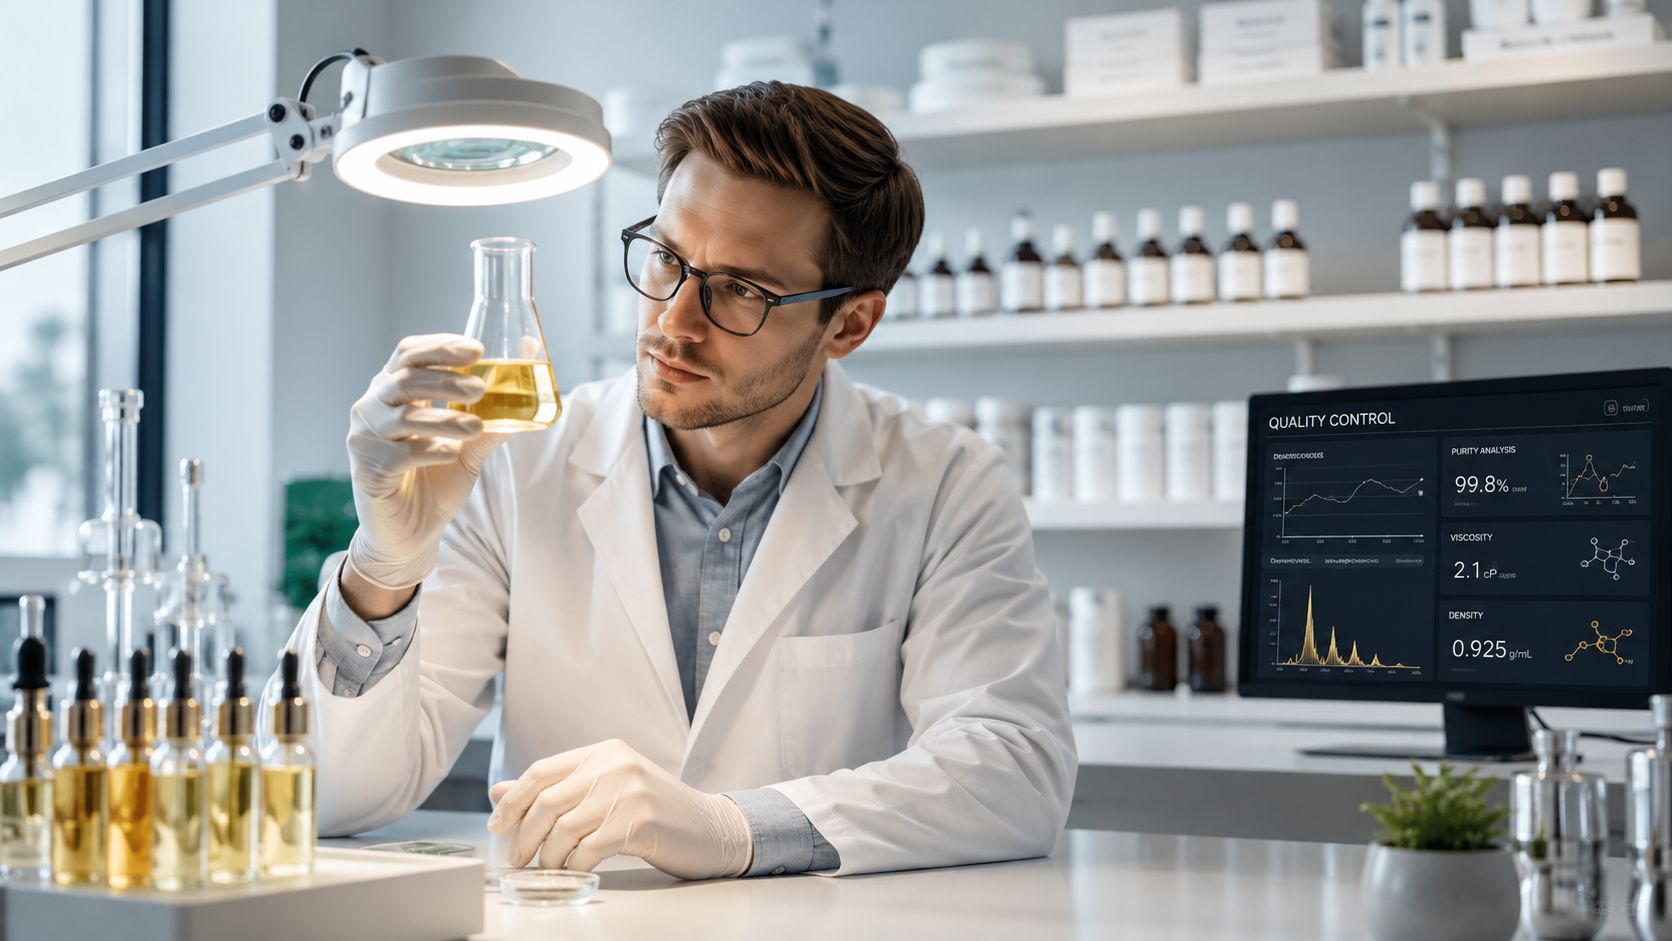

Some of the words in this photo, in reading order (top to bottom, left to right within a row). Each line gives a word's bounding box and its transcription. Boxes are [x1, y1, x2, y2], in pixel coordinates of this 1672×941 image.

[1268, 414, 1326, 431] QUALITY
[1329, 411, 1396, 427] CONTROL
[1451, 447, 1478, 456] PURITY
[1480, 445, 1516, 455] ANALYSIS
[1455, 474, 1509, 494] 99.8%
[1450, 533, 1493, 542] VISCOSITY
[1453, 560, 1479, 579] 2.1
[1484, 568, 1498, 579] cP
[1449, 611, 1484, 620] DENSITY
[1453, 639, 1507, 659] 0.925
[1508, 649, 1533, 661] g/mL
